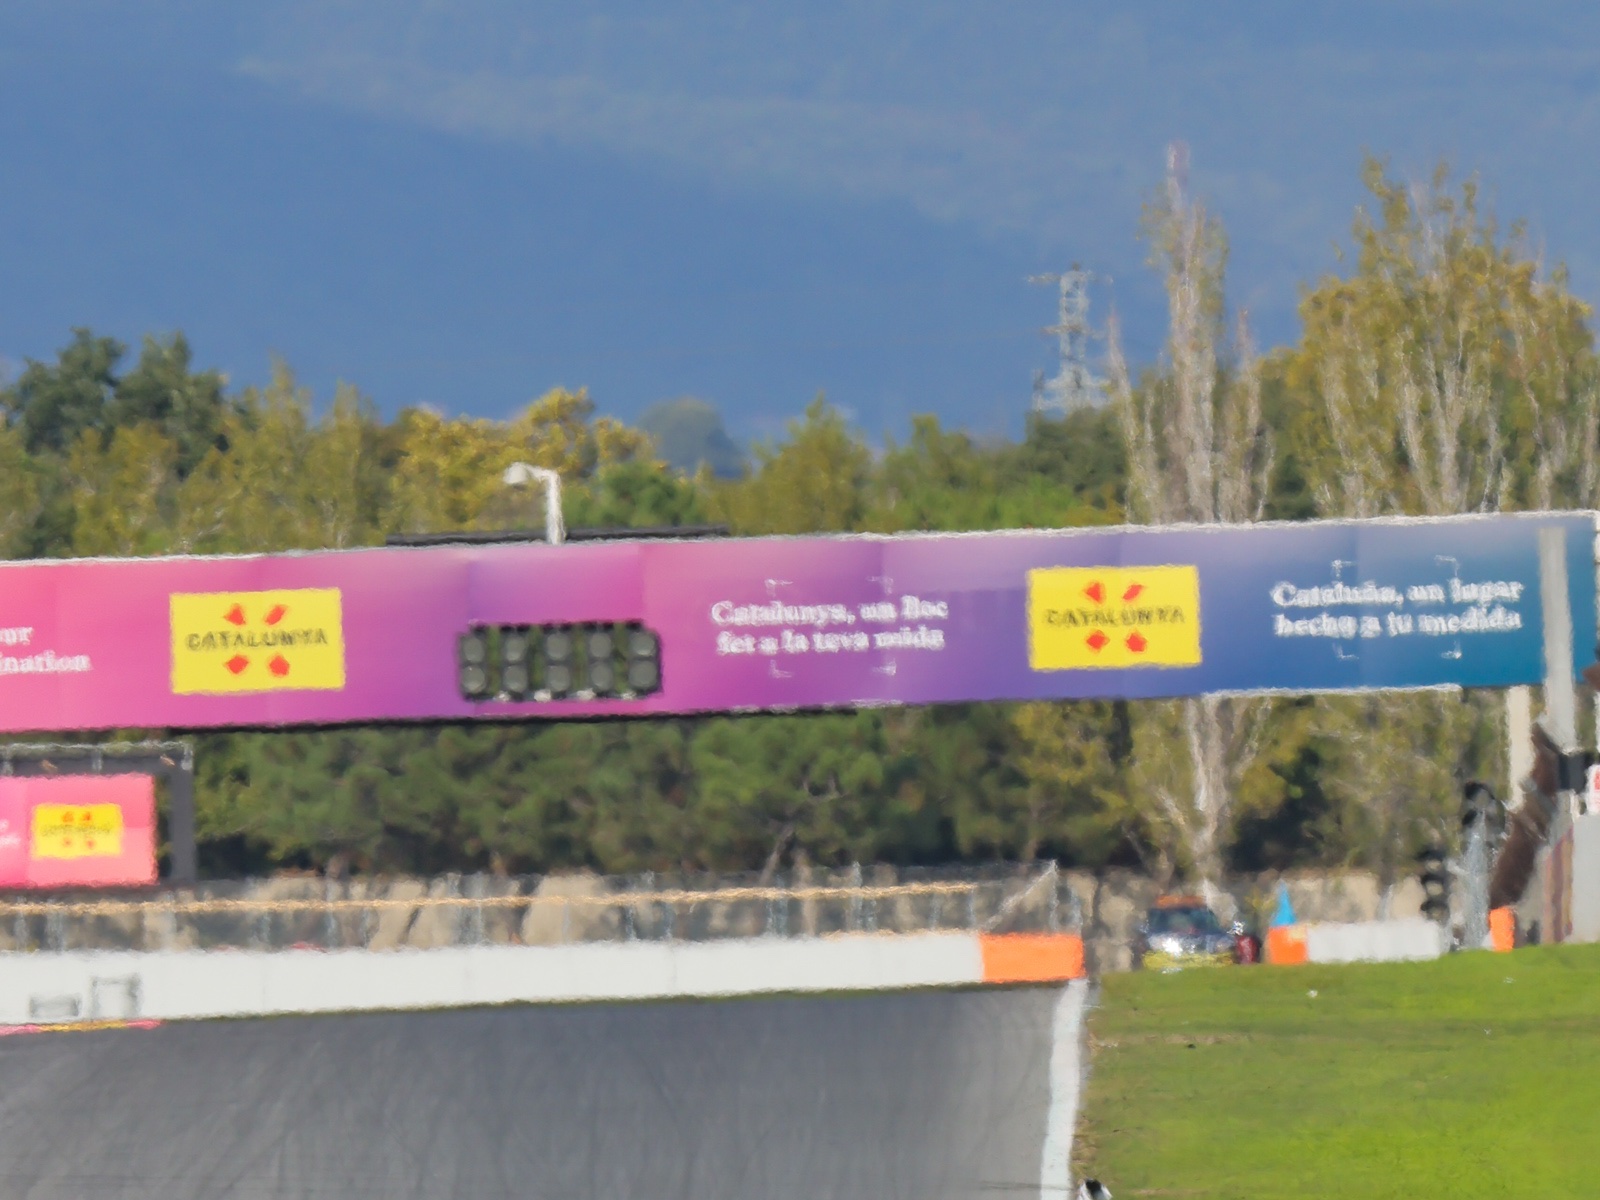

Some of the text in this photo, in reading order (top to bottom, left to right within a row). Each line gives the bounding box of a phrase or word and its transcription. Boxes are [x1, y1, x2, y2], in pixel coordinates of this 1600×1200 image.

[1407, 583, 1445, 602] un
[1449, 576, 1524, 606] lugar
[1046, 606, 1185, 628] CATALUNYA
[1387, 611, 1413, 637] tu
[1418, 604, 1522, 635] medida
[186, 629, 328, 650] CATALUNYA
